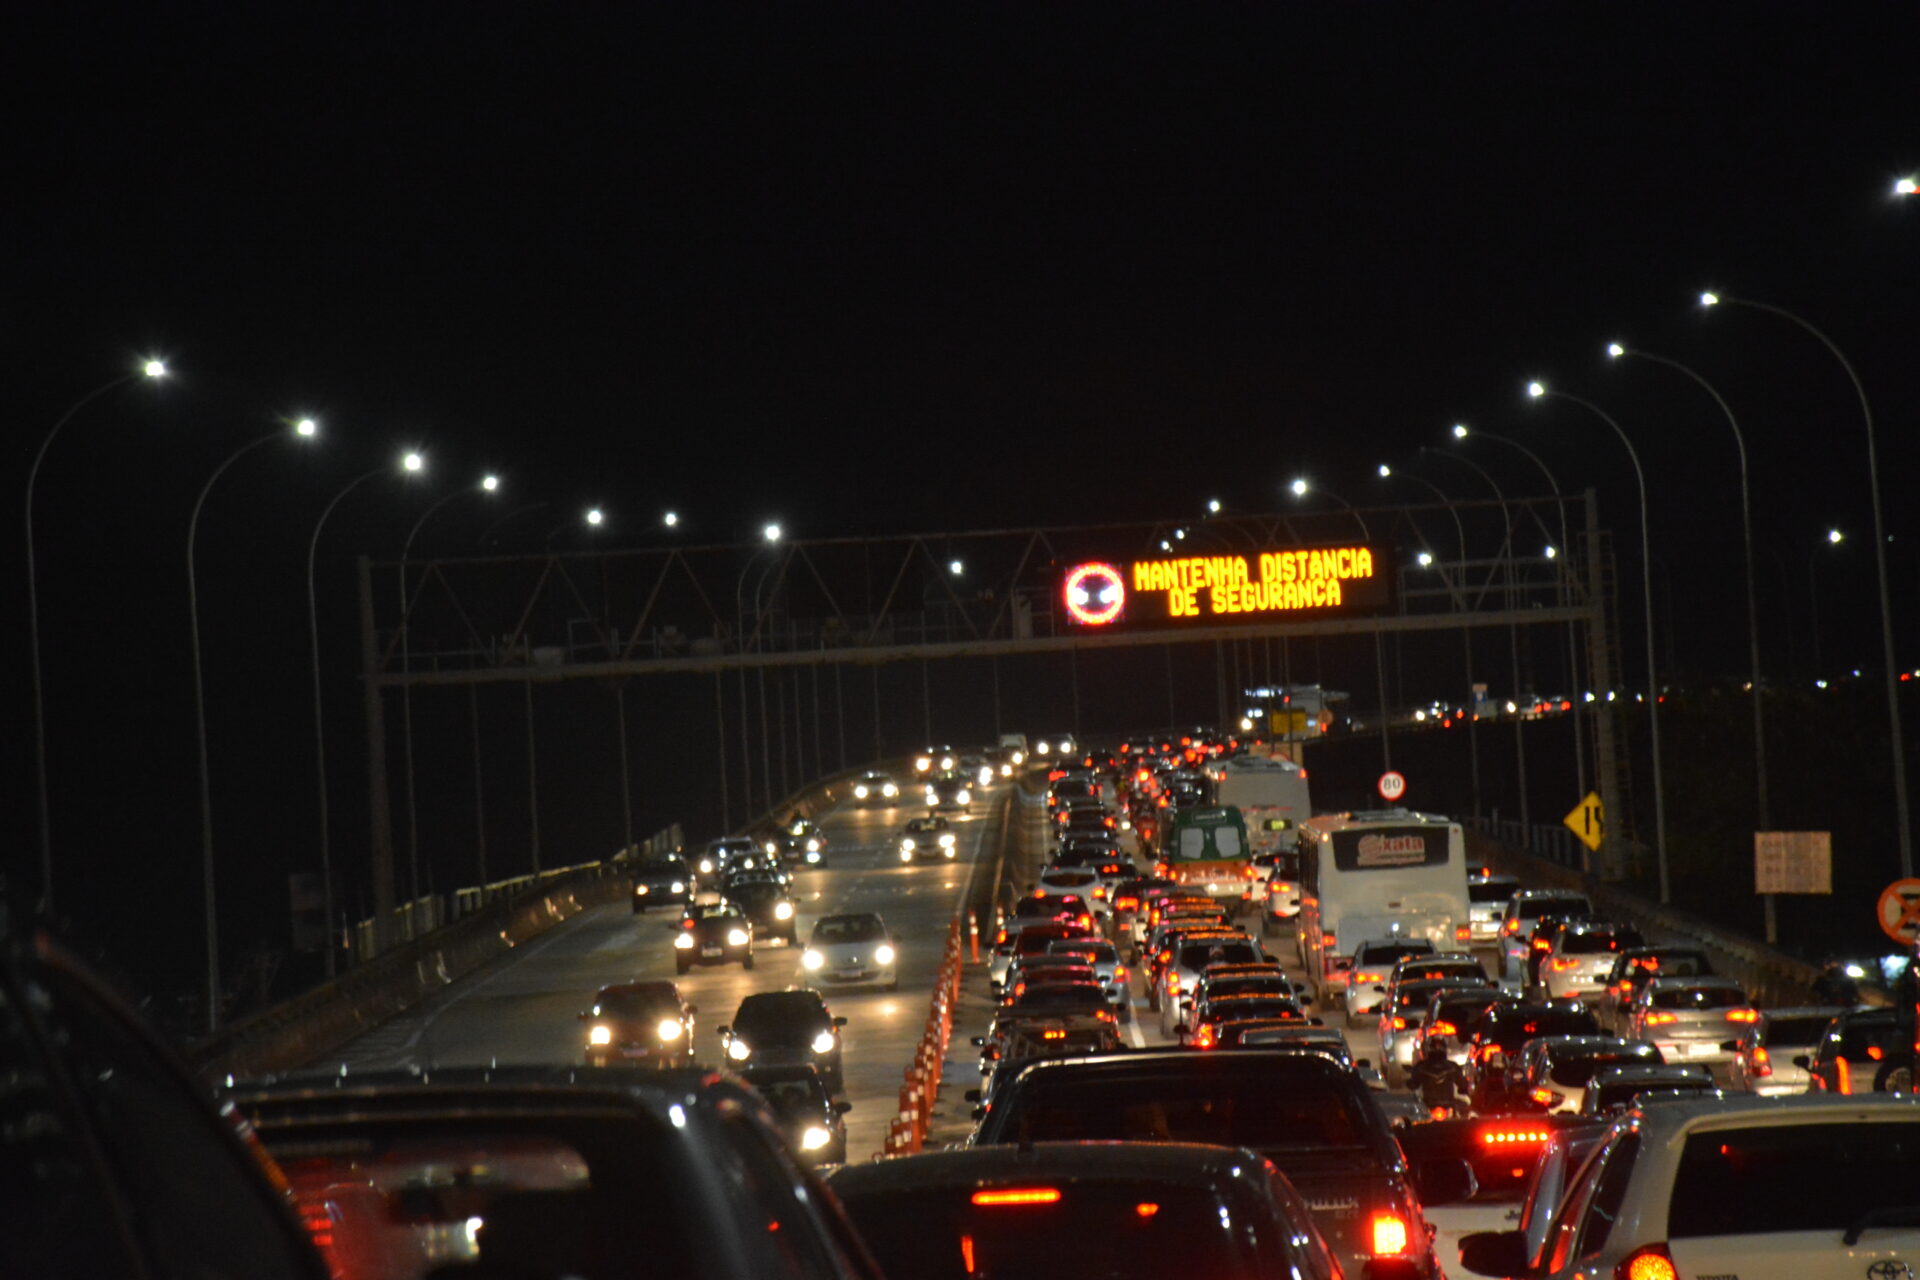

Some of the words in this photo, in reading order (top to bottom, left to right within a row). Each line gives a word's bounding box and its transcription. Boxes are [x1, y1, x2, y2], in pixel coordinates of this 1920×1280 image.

[1135, 557, 1248, 590] MANTENHA
[1170, 587, 1199, 616] DE
[1383, 777, 1401, 790] 80
